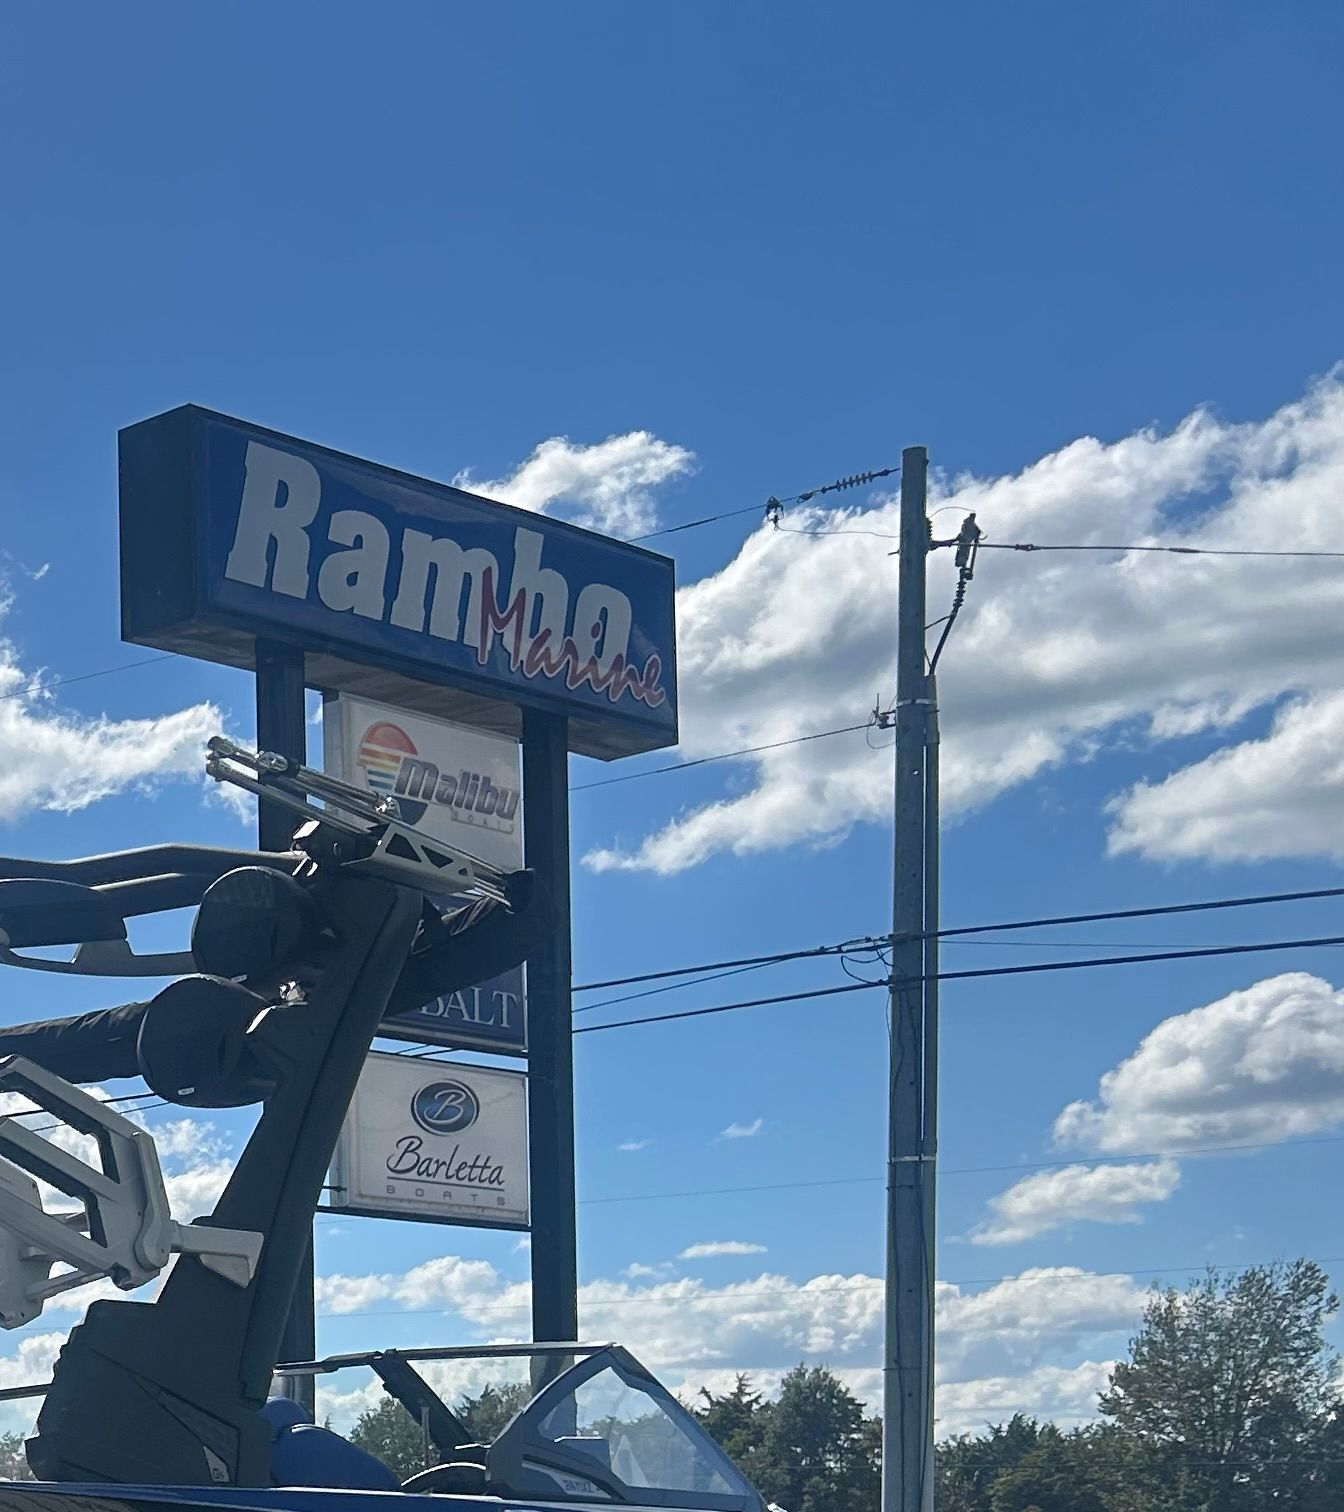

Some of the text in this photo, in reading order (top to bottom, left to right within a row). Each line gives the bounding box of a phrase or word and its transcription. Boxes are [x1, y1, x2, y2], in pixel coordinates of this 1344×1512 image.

[225, 439, 633, 663] Rambo
[477, 566, 666, 708] Marine
[394, 757, 519, 820] Malibu
[386, 1135, 505, 1185] Barletta
[386, 1185, 505, 1206] BOATS
